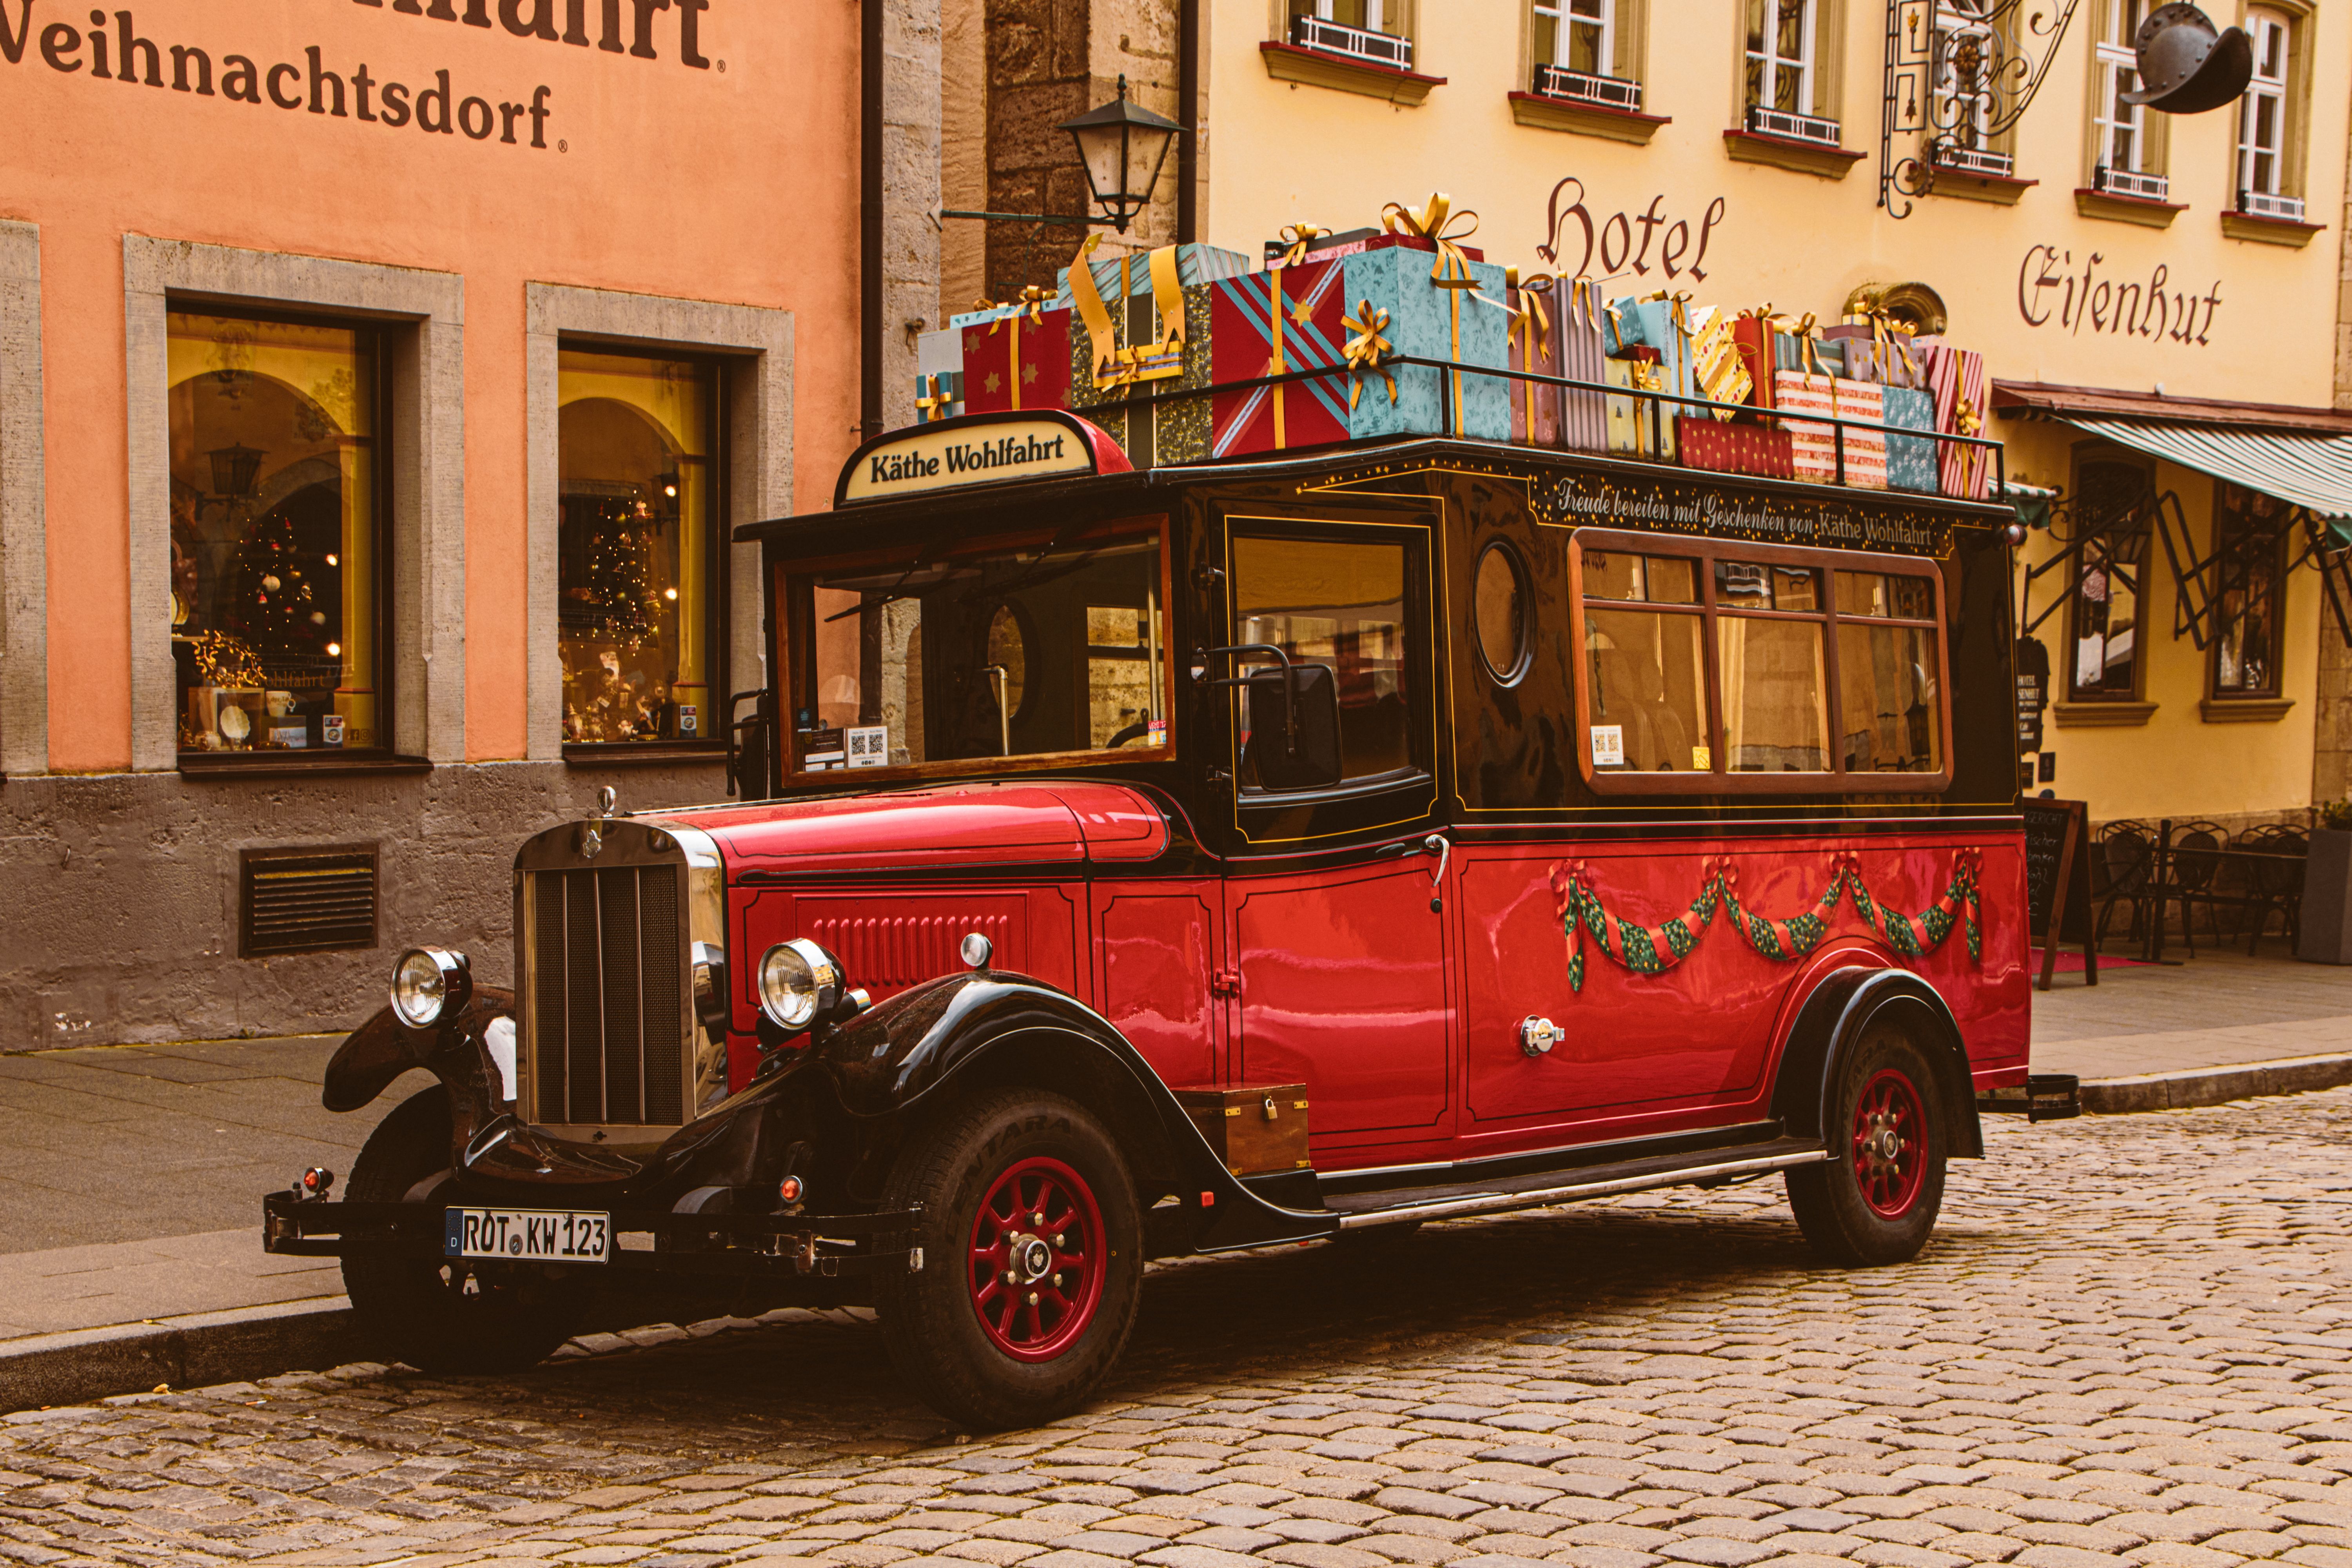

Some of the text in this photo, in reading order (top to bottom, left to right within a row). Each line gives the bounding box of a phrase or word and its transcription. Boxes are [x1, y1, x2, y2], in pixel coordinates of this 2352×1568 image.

[1536, 176, 1725, 283] Hotel
[870, 434, 1064, 483] Käthe Wohlfahrt
[1558, 477, 1932, 545] Freude bereiten mit Geschenken von Käthe Wohlfahrt
[2018, 675, 2035, 686] HOTEL
[944, 1115, 1073, 1245] CENTARA
[451, 1237, 457, 1247] D
[463, 1215, 606, 1256] ROT KW 123
